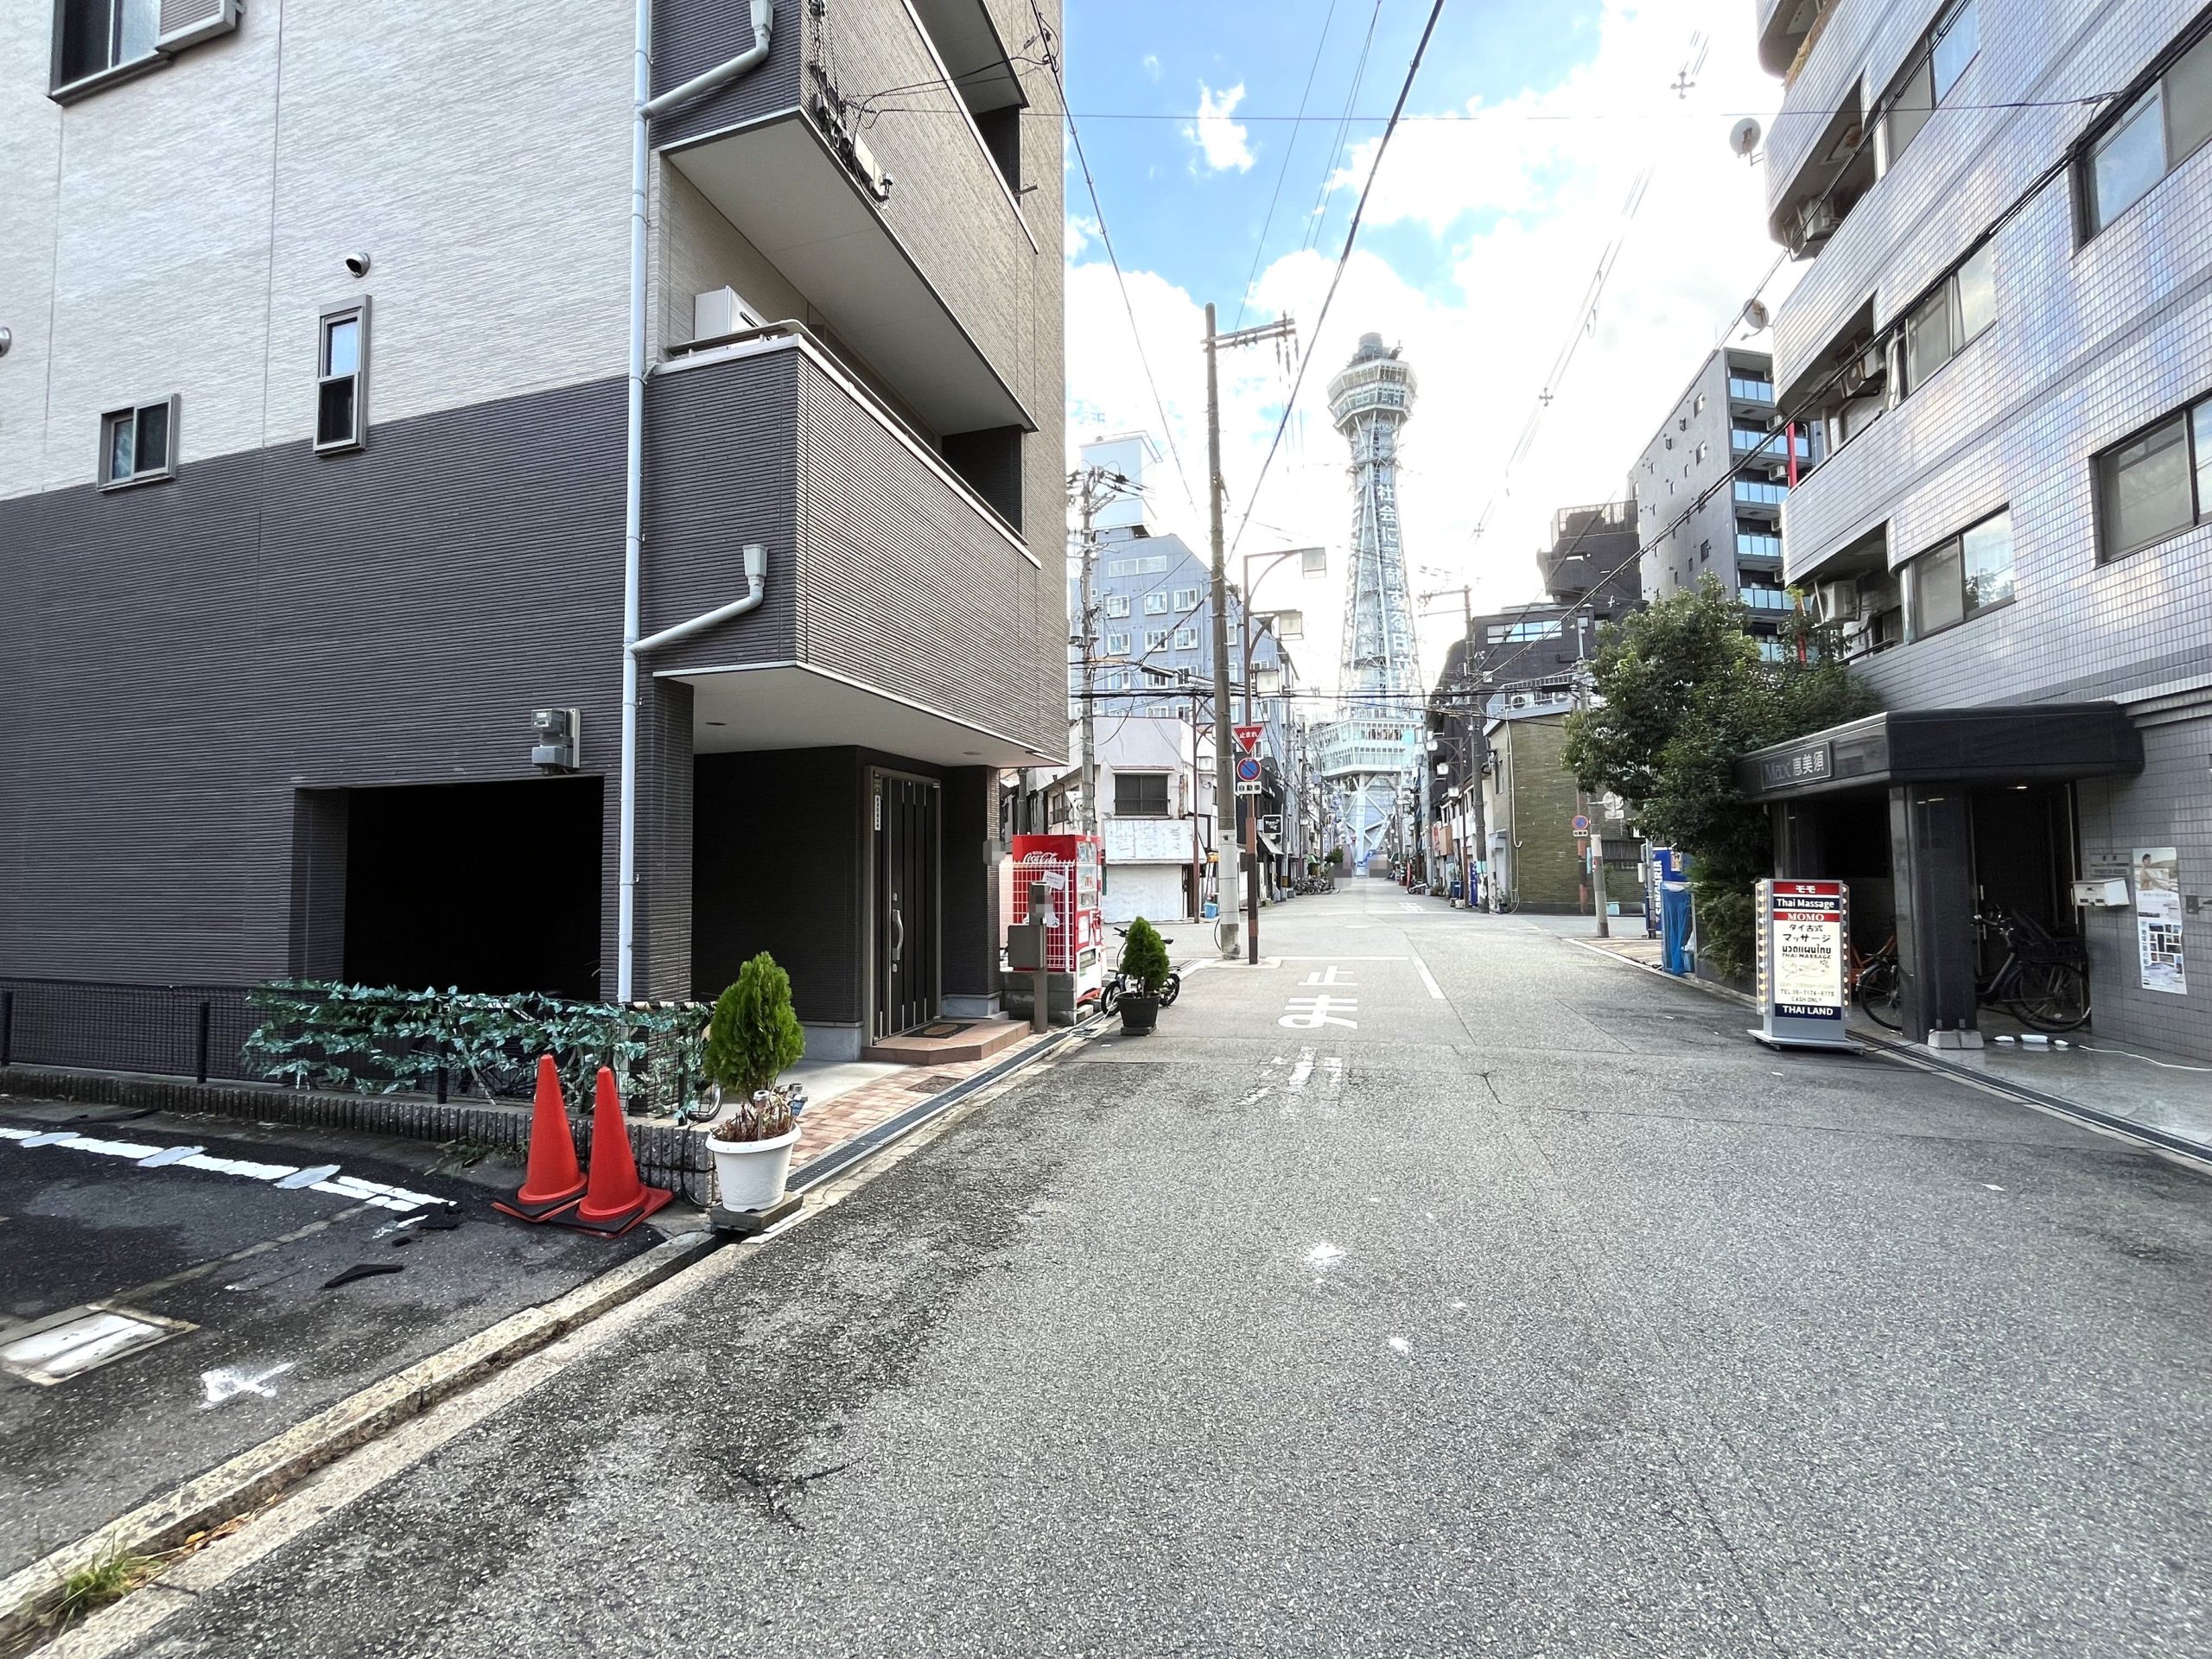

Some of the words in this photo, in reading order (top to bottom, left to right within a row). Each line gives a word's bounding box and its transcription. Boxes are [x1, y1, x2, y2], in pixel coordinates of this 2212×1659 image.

[1792, 750, 1824, 777] 恵美須
[1764, 761, 1791, 781] Max
[1653, 860, 1662, 915] SANGARIA
[1795, 885, 1816, 894] モモ
[1777, 899, 1796, 907] Thai
[1797, 899, 1834, 910] Massage
[1787, 912, 1824, 921] MOMO
[1789, 924, 1823, 932] タイ古式
[1783, 933, 1831, 943] マッサージ
[1783, 1005, 1805, 1014] THAI
[1808, 1007, 1834, 1015] LAND
